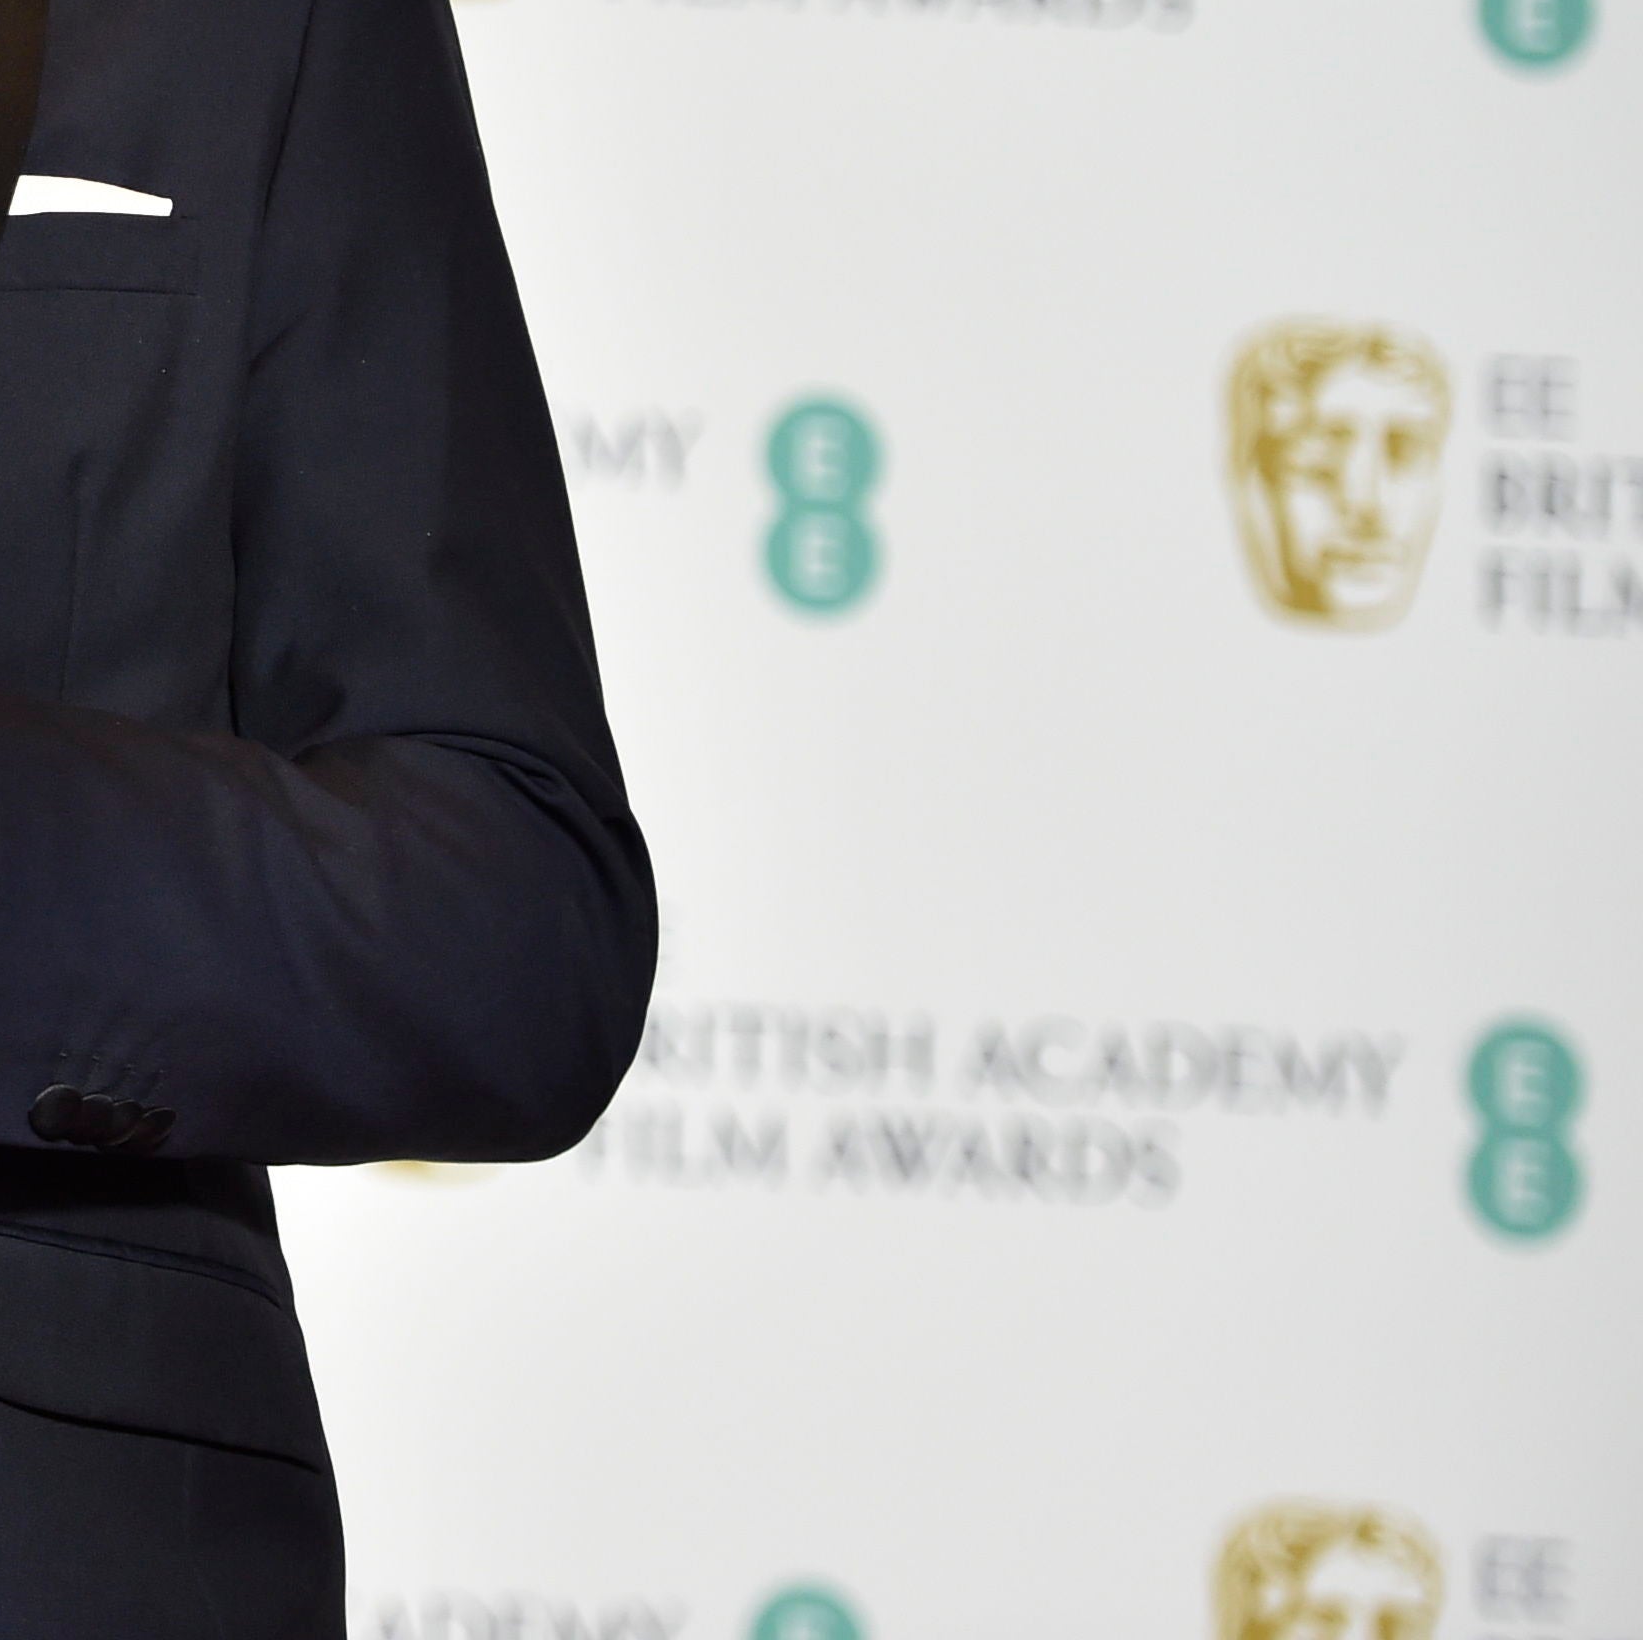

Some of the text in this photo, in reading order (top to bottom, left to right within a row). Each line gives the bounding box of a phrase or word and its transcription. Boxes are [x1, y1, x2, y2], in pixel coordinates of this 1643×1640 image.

[1481, 455, 1643, 538] BRI
[967, 1018, 1404, 1118] ACADEMY
[808, 1111, 1181, 1212] AWARDS
